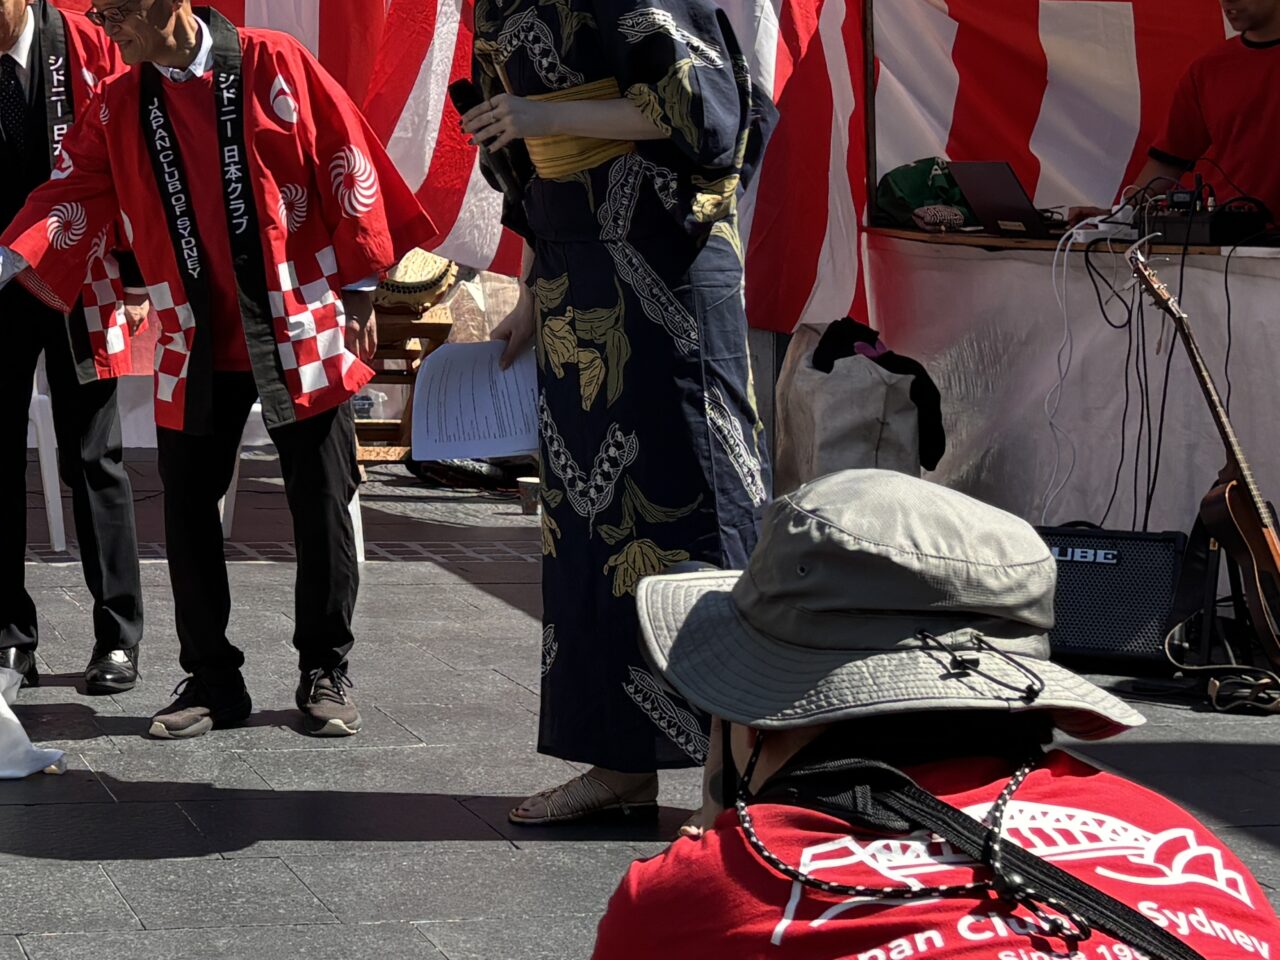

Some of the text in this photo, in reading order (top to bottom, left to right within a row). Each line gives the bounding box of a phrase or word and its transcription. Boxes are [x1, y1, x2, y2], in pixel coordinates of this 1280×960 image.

[48, 55, 66, 117] シドニー
[219, 73, 248, 234] シドニー 日本クラブ
[149, 97, 201, 279] JAPAN CLUB OF SYDNEY
[1053, 547, 1118, 564] UBE
[1137, 901, 1270, 959] Sydney
